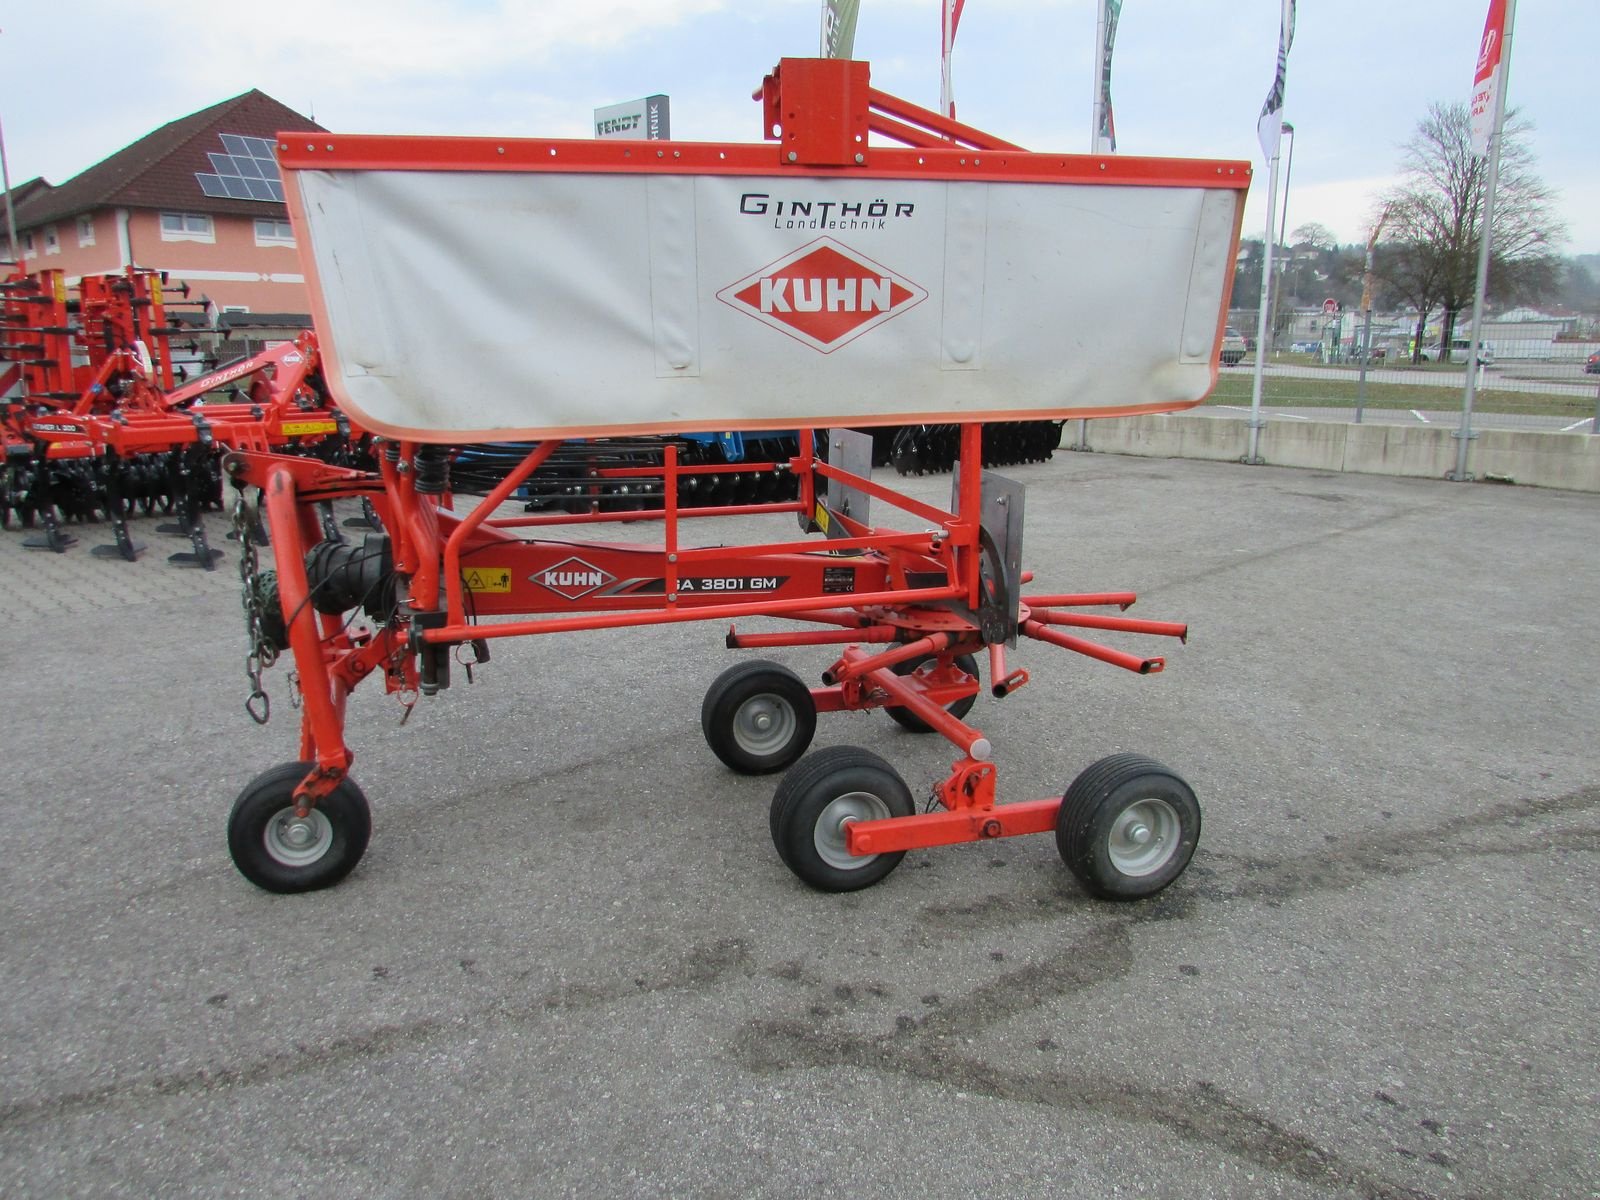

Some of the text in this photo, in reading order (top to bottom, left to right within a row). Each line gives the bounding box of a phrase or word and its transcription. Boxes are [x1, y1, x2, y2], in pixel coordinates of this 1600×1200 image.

[597, 114, 642, 136] FENDT
[740, 193, 914, 228] GINTHÖR
[760, 277, 891, 312] KUHN
[545, 572, 602, 586] KUHN
[701, 578, 744, 590] 3801
[750, 577, 777, 589] GM
